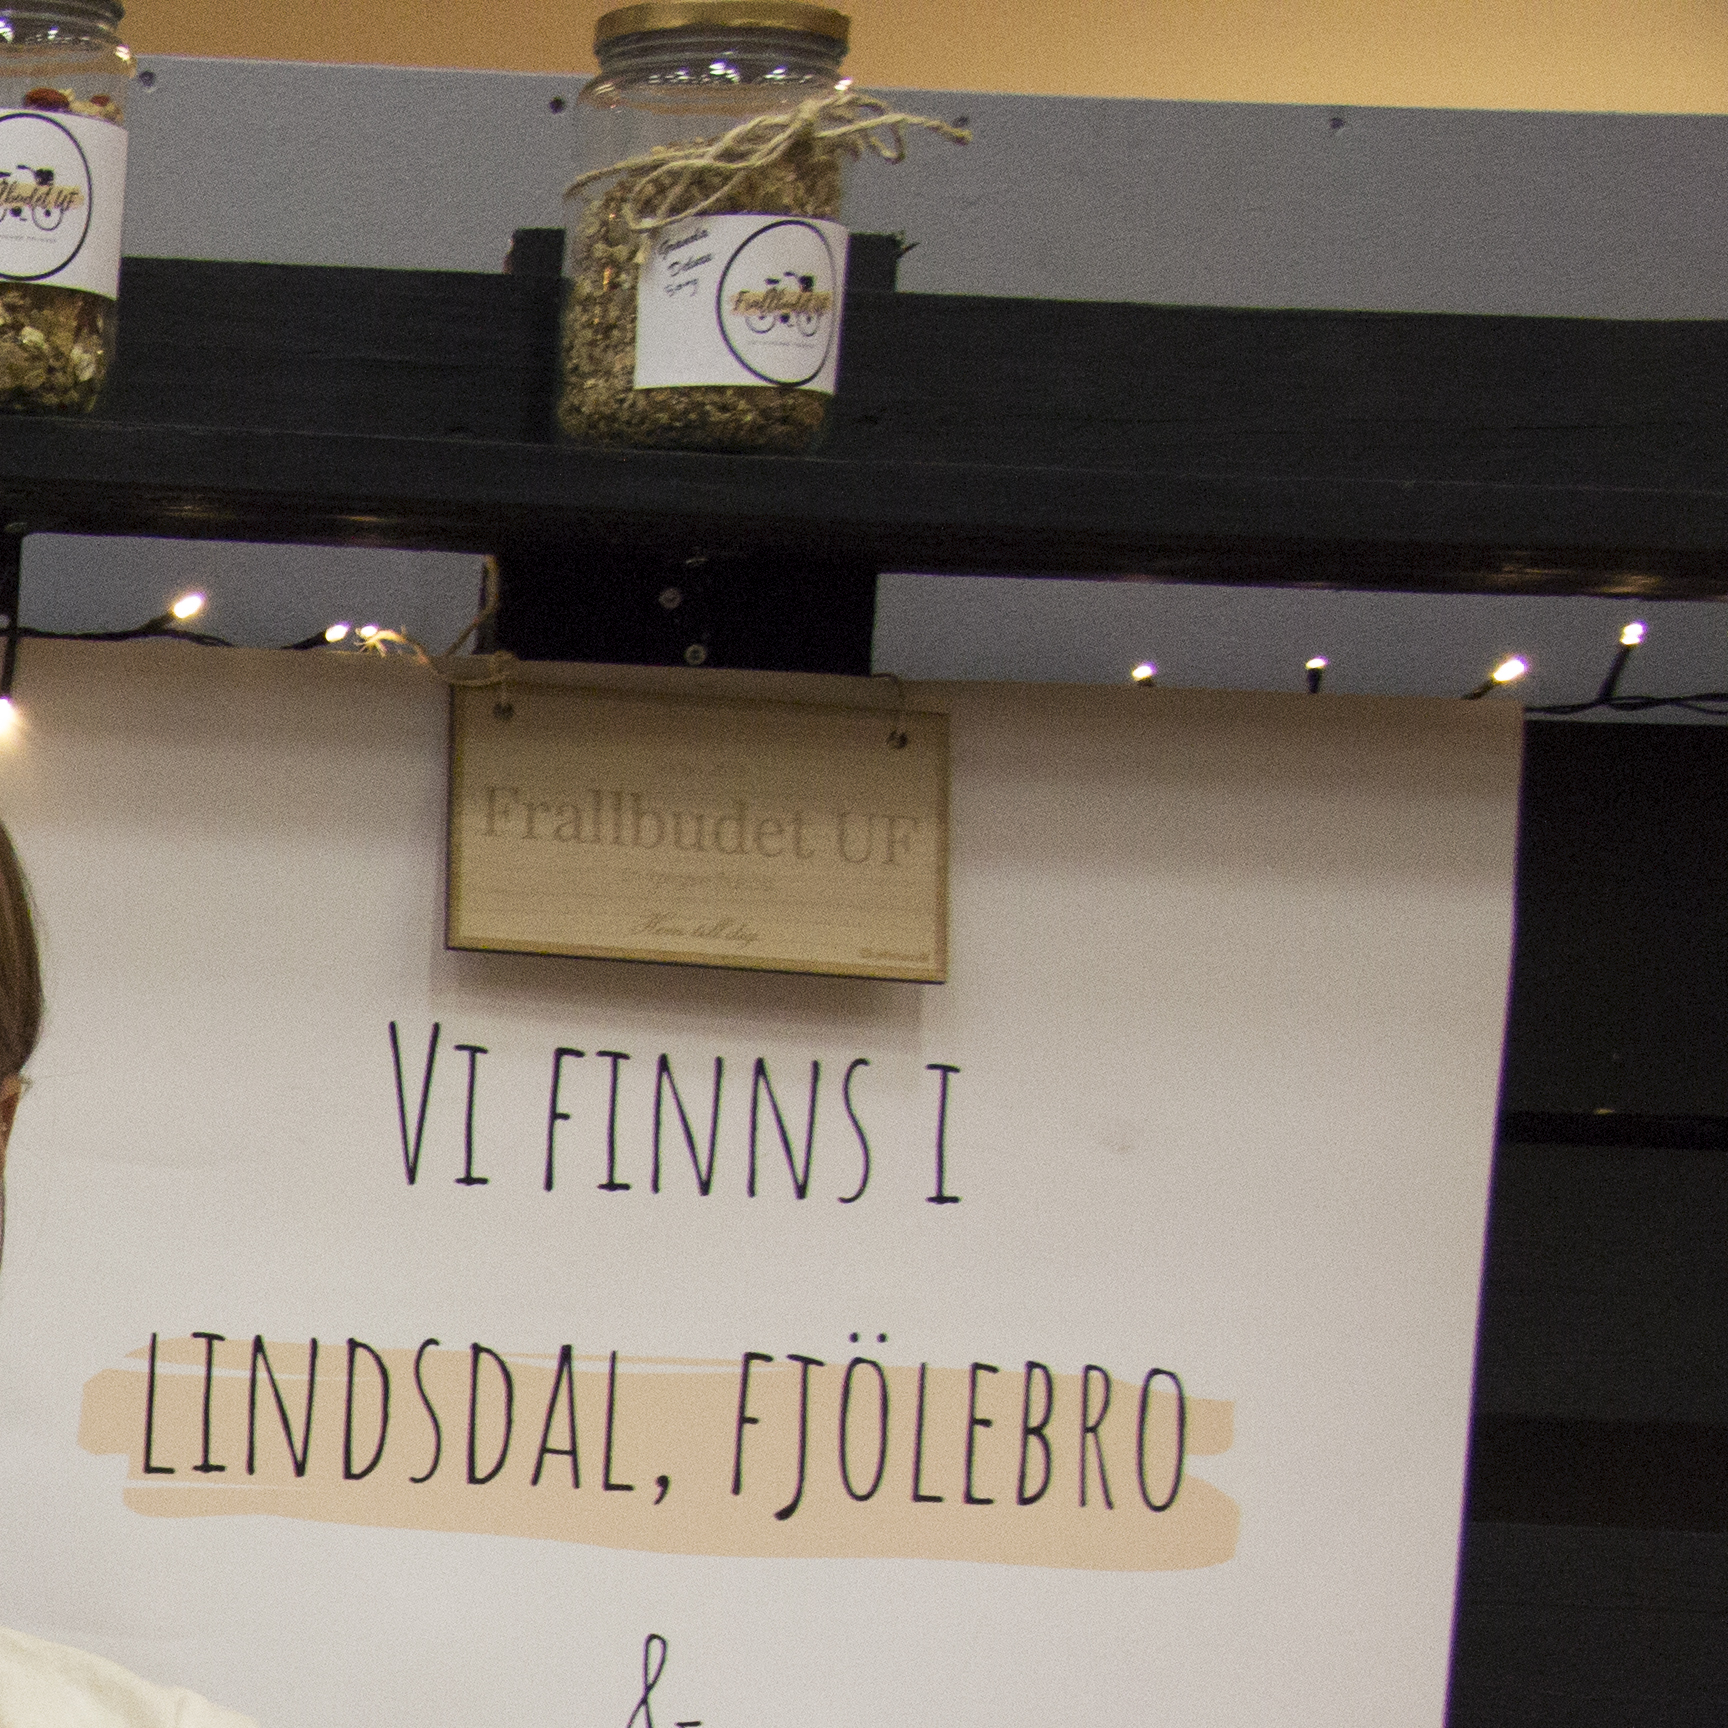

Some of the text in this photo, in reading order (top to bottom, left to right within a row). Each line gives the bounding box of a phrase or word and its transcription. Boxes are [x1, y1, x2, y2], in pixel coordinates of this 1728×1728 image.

[480, 784, 920, 868] Frallbudet UF
[388, 1020, 961, 1205] VI FINNS I
[142, 1330, 1188, 1522] LINDSDAL, FJÖLEBRO
